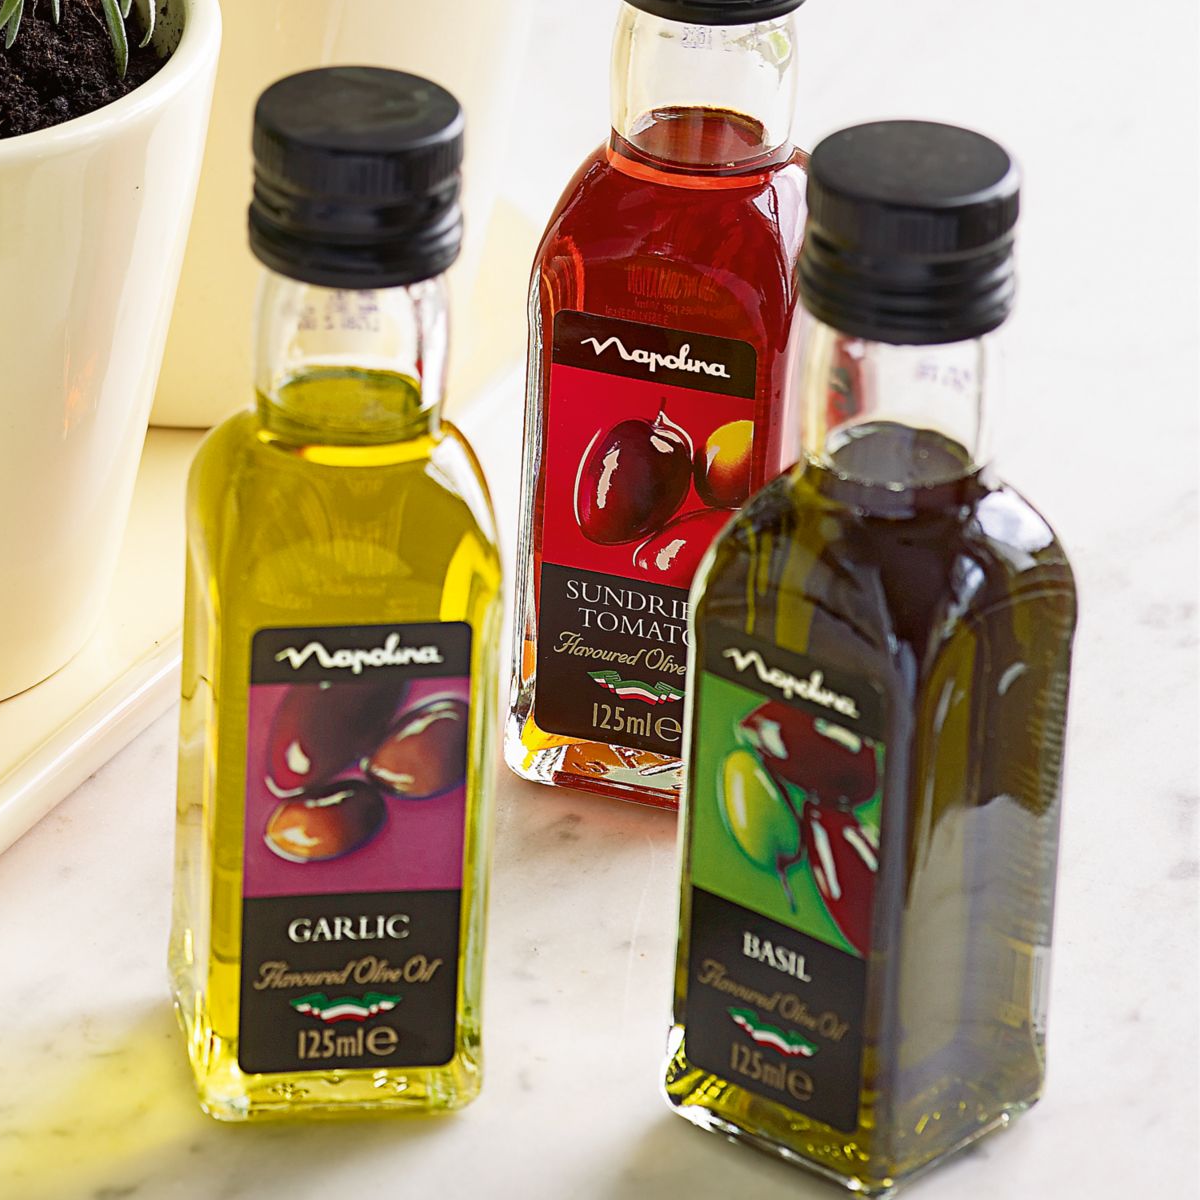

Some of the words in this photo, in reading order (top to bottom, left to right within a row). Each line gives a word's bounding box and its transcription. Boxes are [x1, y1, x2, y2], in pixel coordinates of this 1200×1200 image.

[580, 336, 731, 378] Napolina
[566, 580, 691, 621] SUNDRIE
[274, 632, 445, 675] Napolina
[553, 631, 646, 666] Flavoured
[645, 648, 687, 675] Olive
[722, 648, 860, 719] Napolina
[288, 914, 410, 943] GARLIC
[253, 960, 357, 990] Flavoured
[354, 955, 402, 984] Olive
[403, 954, 443, 983] Oil
[743, 931, 812, 982] BASIL
